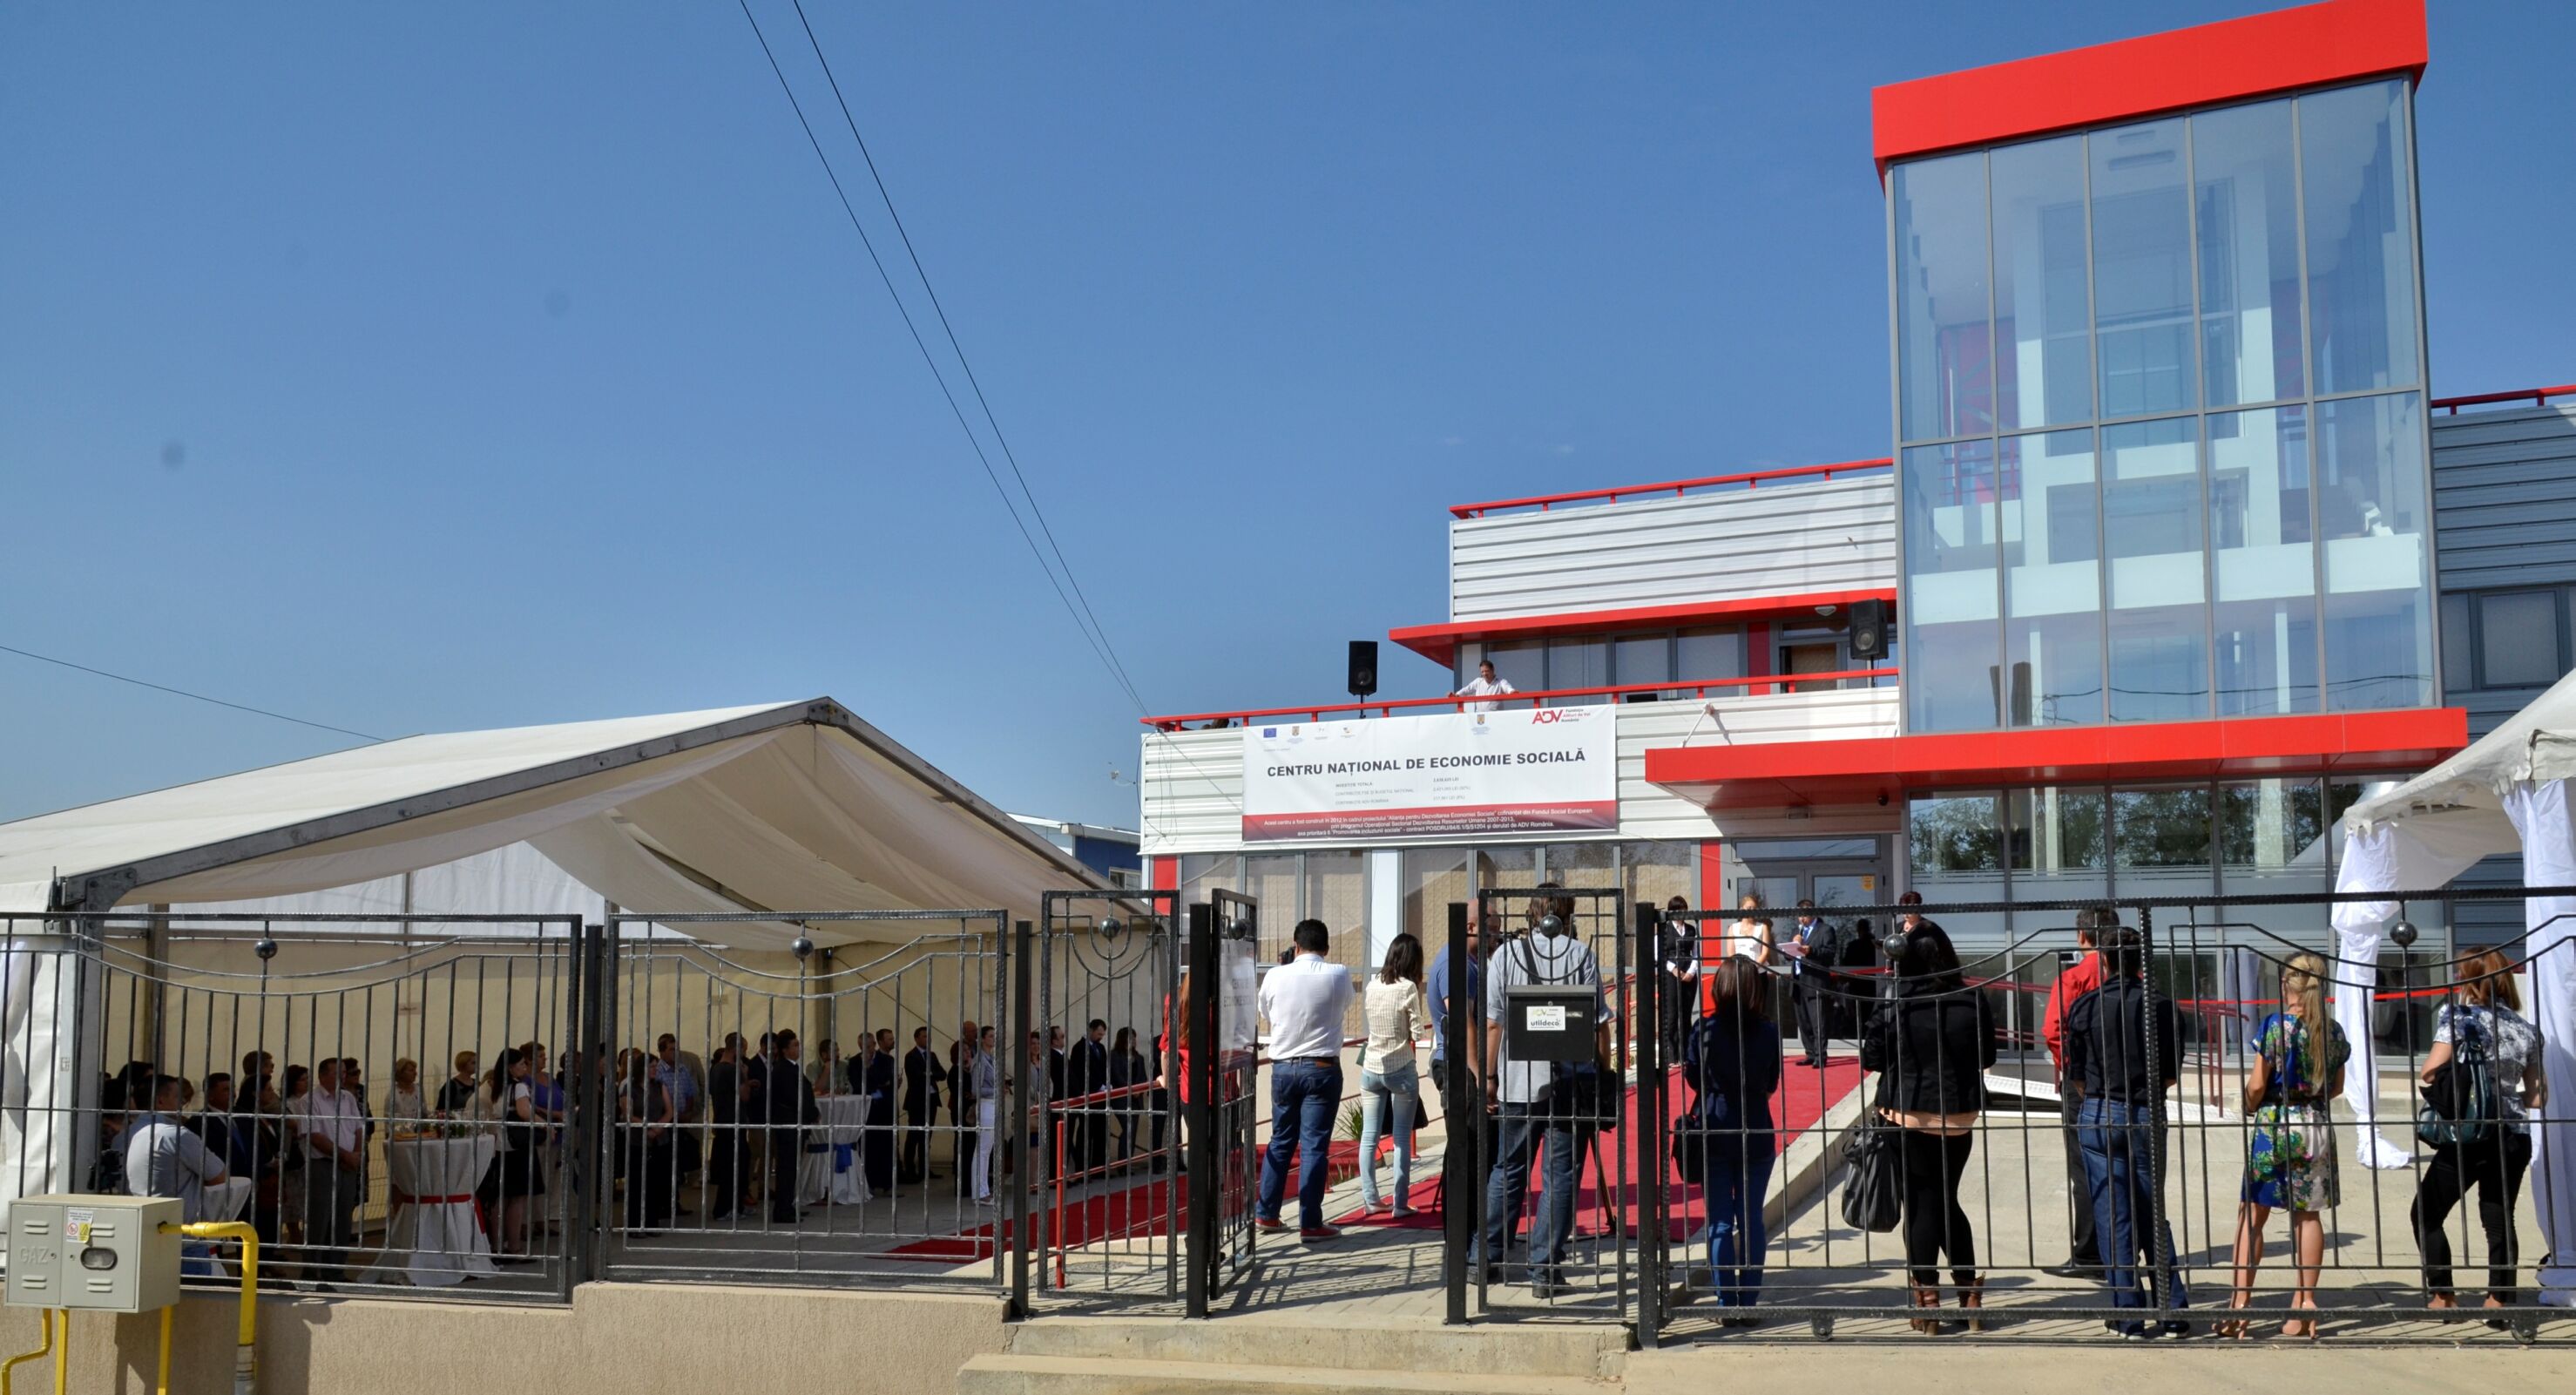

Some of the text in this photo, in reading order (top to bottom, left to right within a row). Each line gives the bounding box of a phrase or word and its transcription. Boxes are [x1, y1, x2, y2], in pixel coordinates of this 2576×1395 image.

[1268, 747, 1585, 776] CENTRU NAȚIONAL DE ECONOMIE SOCIALĂ
[20, 1246, 49, 1264] GAZ
